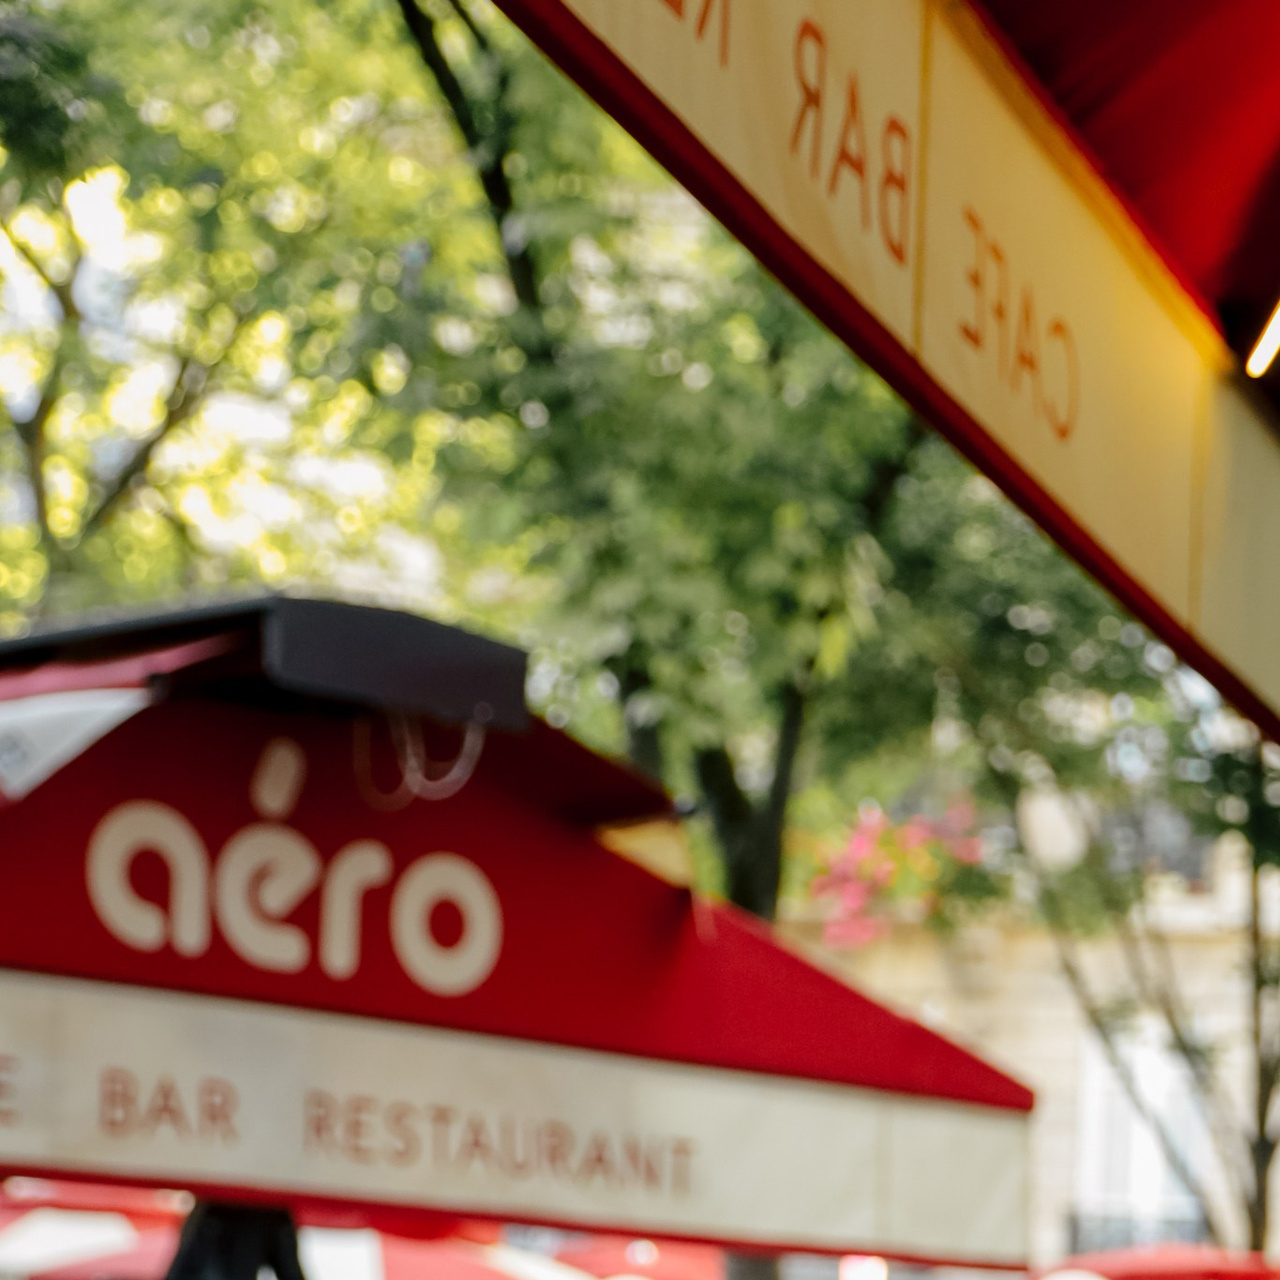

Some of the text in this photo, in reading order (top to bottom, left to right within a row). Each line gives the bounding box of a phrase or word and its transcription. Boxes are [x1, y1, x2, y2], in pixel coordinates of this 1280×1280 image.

[84, 735, 505, 999] aéro
[99, 1066, 242, 1147] BAR
[304, 1089, 696, 1194] RESTAURANT
